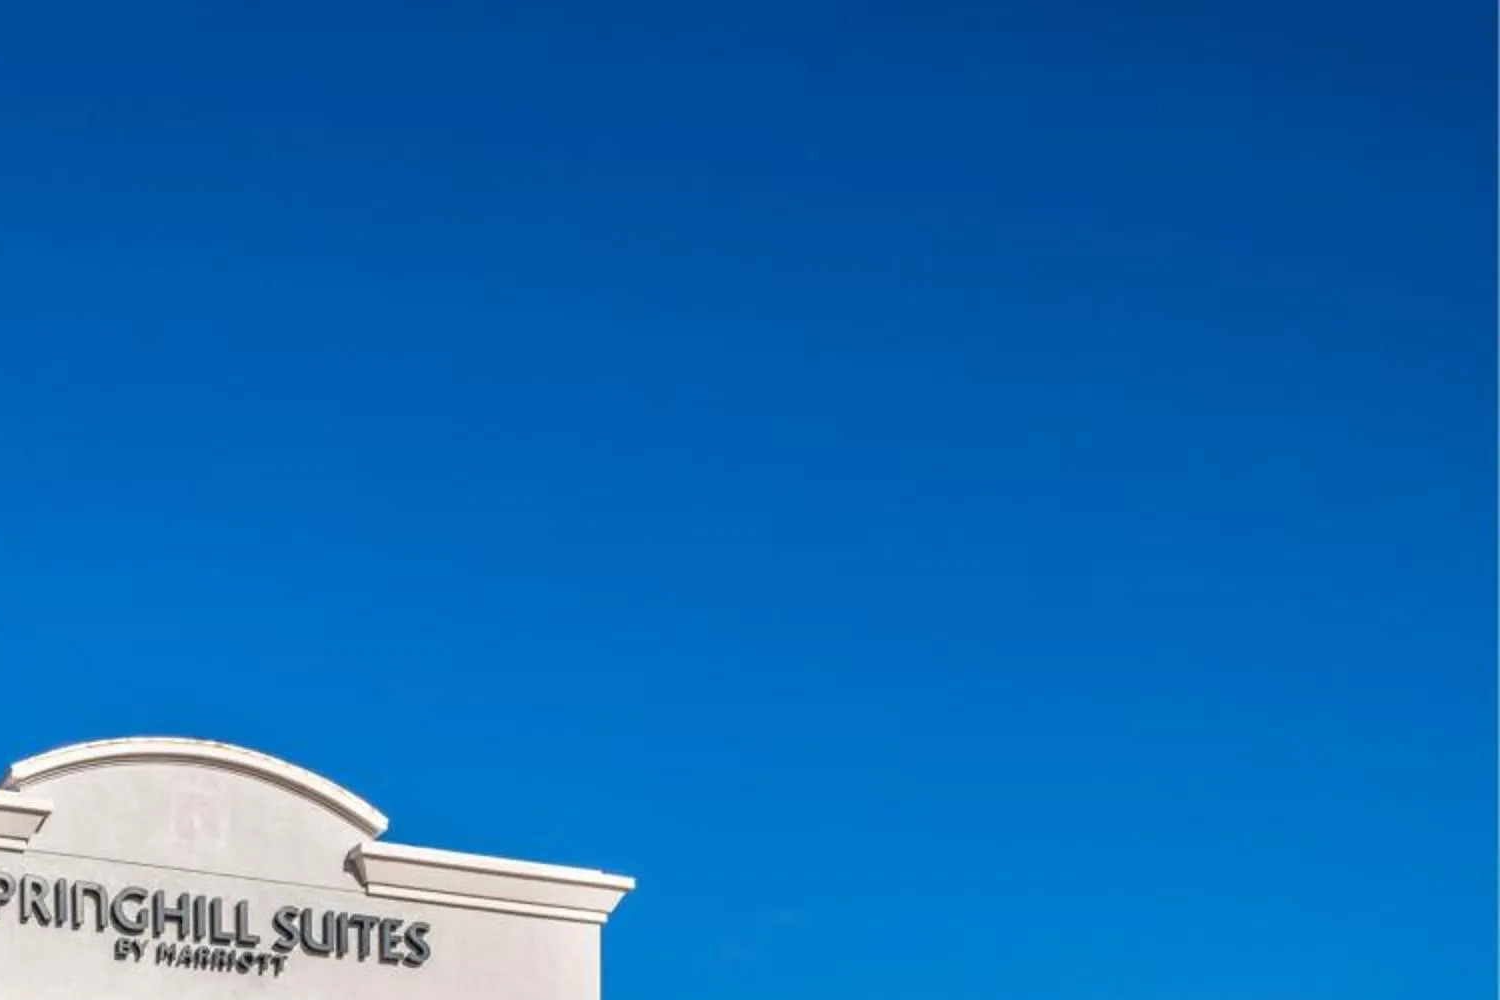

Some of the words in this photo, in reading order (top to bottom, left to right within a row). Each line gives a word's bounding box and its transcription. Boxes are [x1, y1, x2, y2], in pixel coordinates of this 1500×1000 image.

[113, 937, 149, 962] BY
[155, 942, 289, 978] MARRIOTT
[271, 905, 432, 968] SUITES
